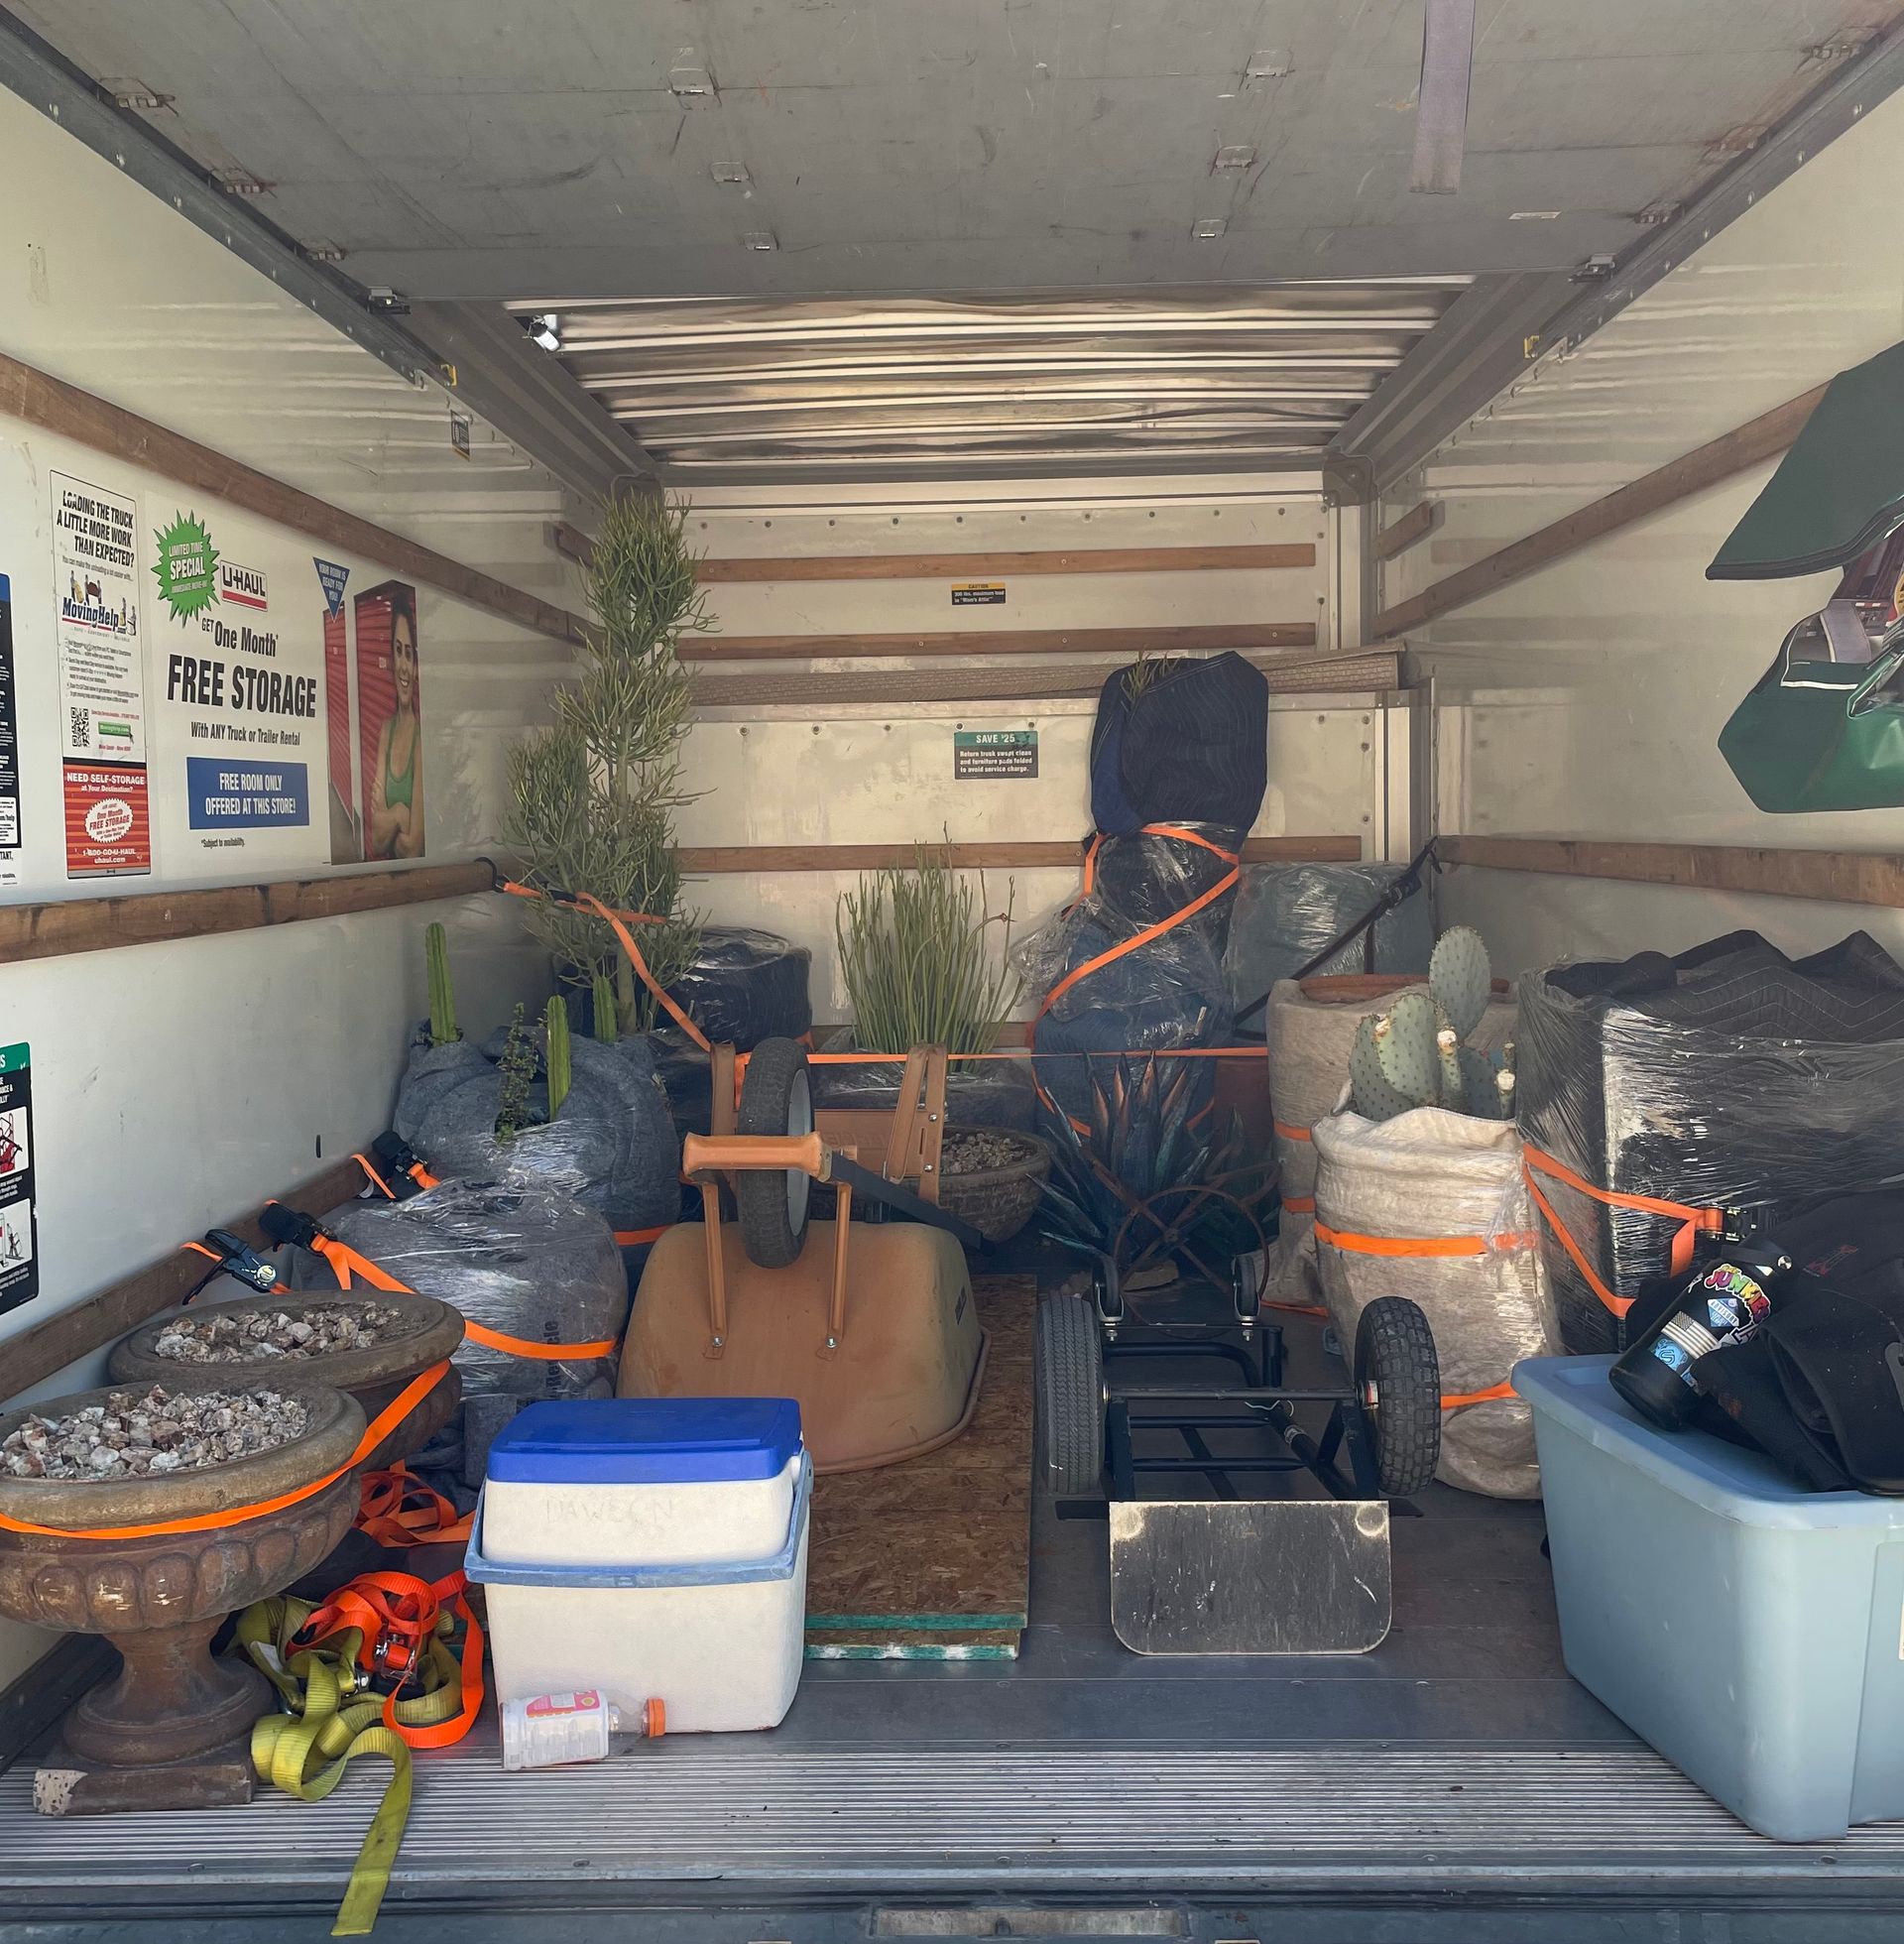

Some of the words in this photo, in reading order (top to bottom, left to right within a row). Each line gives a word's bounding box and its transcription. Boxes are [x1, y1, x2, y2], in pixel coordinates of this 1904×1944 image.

[62, 490, 94, 516] LOADING
[96, 501, 110, 521] THE
[111, 506, 133, 529] TRUCK
[57, 509, 62, 526] A
[64, 511, 88, 534] LITTLE
[89, 520, 110, 541] MORE
[111, 527, 132, 547] WORK
[74, 535, 94, 556] THAN
[95, 541, 134, 568] EXPECTED?
[170, 556, 205, 580] SPECIAL
[222, 565, 265, 597] U-HAUL
[202, 617, 214, 633] GET
[215, 620, 238, 649] One
[167, 654, 225, 707] FREE
[232, 665, 317, 718] STORAGE
[191, 722, 209, 739] With
[210, 724, 226, 740] ANY
[228, 725, 247, 741] Truck
[248, 729, 256, 742] or
[258, 729, 279, 744] Trailer
[280, 730, 300, 746] Rental
[976, 734, 998, 743] SAVE
[1001, 734, 1015, 743] $25
[67, 772, 88, 782] NEED
[90, 774, 145, 785] SELF-STORAGE
[219, 773, 239, 791] FREE
[241, 773, 263, 791] ROOM
[265, 775, 282, 791] ONLY
[206, 797, 241, 815] OFFERED
[242, 797, 251, 815] AT
[253, 797, 270, 815] THIS
[271, 798, 296, 814] STORE!
[89, 820, 103, 831] FREE
[105, 814, 130, 827] STORAGE
